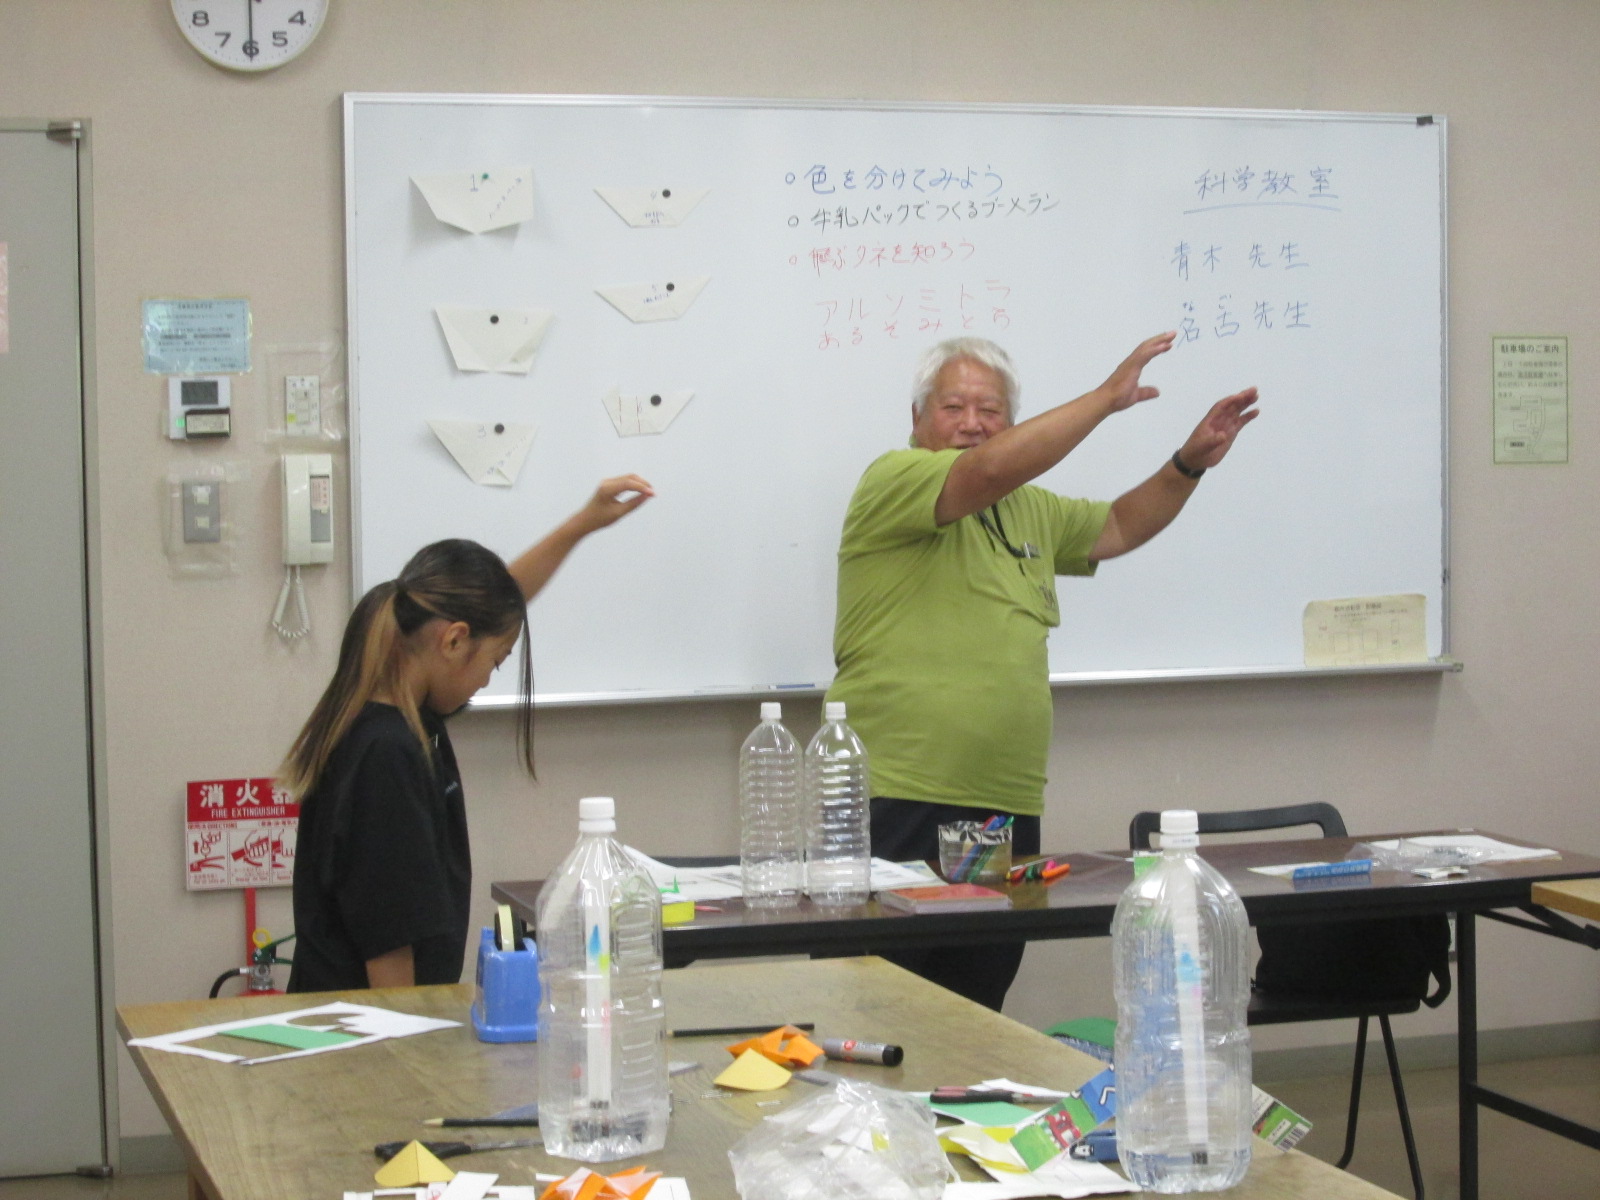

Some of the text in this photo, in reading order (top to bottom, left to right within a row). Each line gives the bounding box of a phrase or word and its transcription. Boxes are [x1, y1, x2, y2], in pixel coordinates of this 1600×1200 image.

[192, 10, 209, 27] 8
[288, 10, 306, 26] 4
[214, 31, 231, 48] 7
[272, 31, 288, 47] 5
[242, 40, 259, 56] 6
[804, 164, 1003, 196] 色を分けてみよう
[1194, 165, 1339, 200] 科学教室
[1171, 241, 1310, 281] 青木 先生
[1500, 343, 1560, 354] 駐車場のご案内
[211, 805, 286, 818] FIRE EXTINGUISHER
